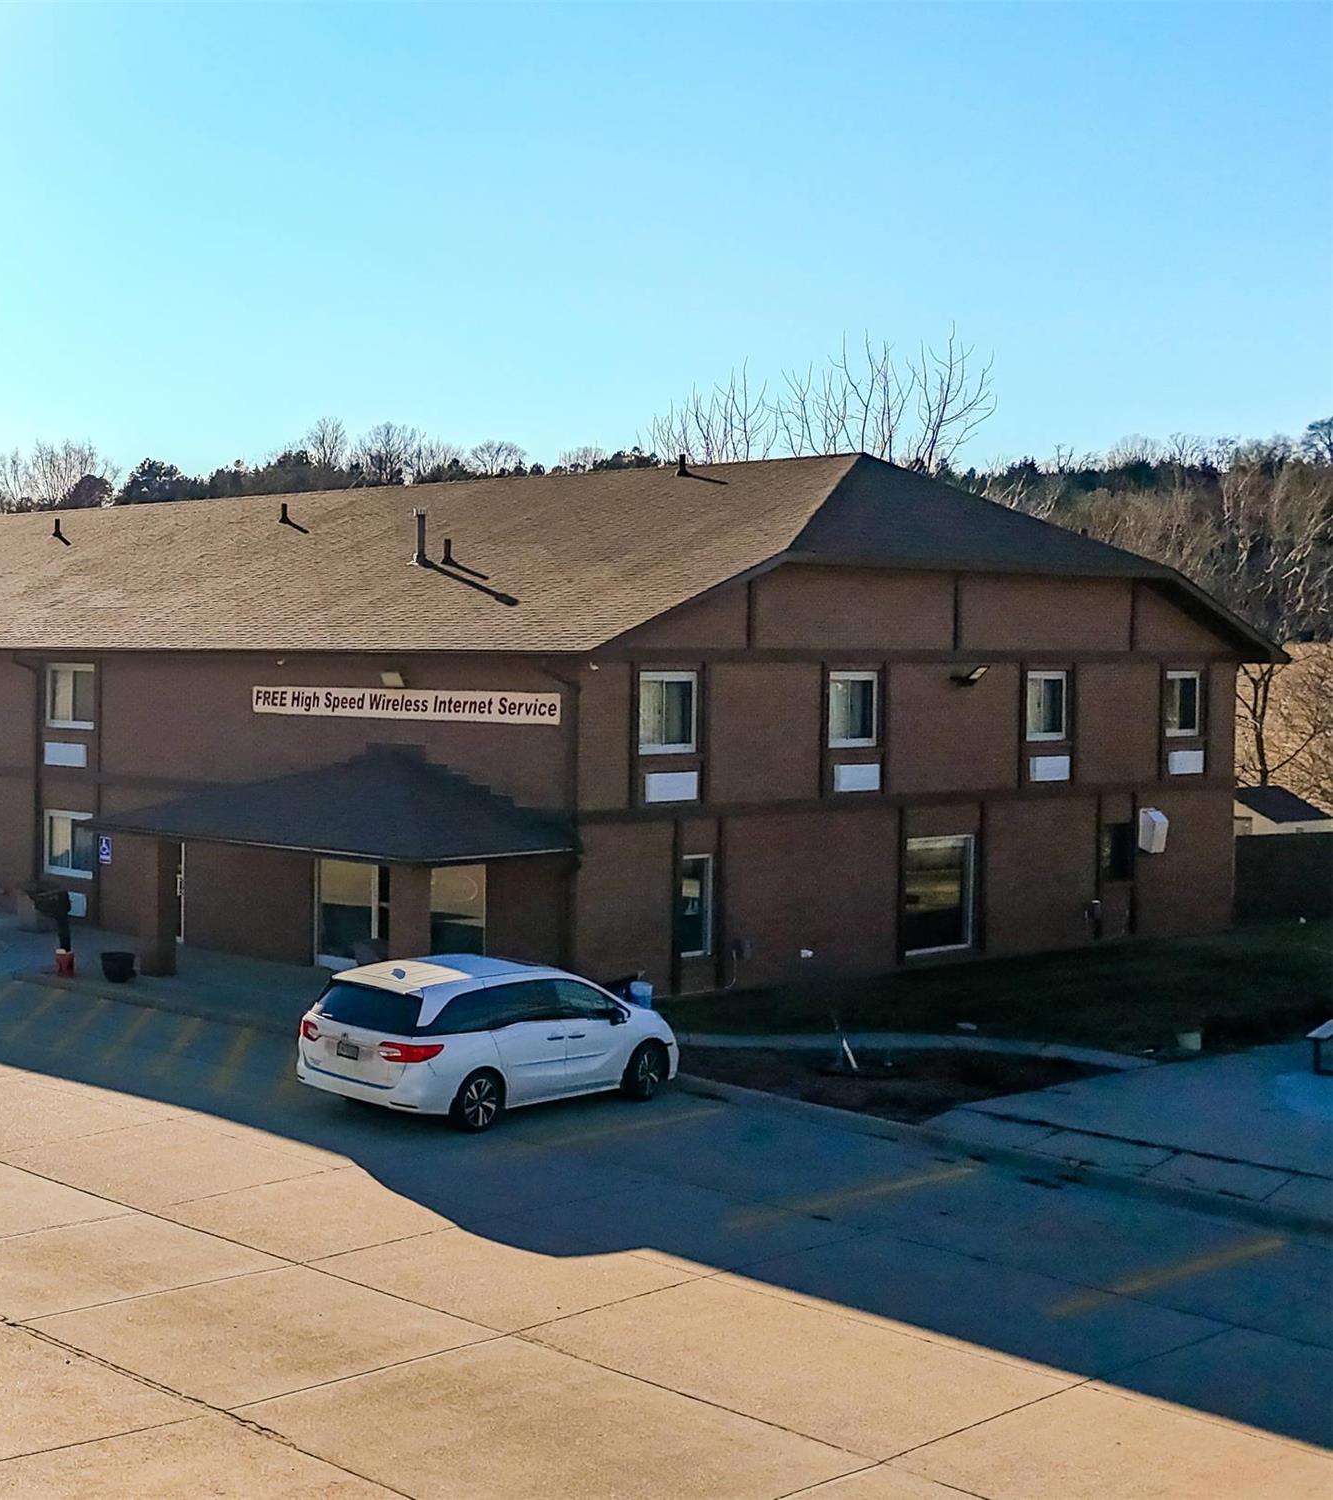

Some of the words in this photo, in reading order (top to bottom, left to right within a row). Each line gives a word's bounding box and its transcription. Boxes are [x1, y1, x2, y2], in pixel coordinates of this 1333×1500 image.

[255, 690, 288, 707] FREE
[291, 691, 320, 712] High
[324, 692, 366, 713] Speed
[369, 693, 429, 713] Wireless
[433, 695, 493, 715] Internet
[498, 697, 558, 717] Service
